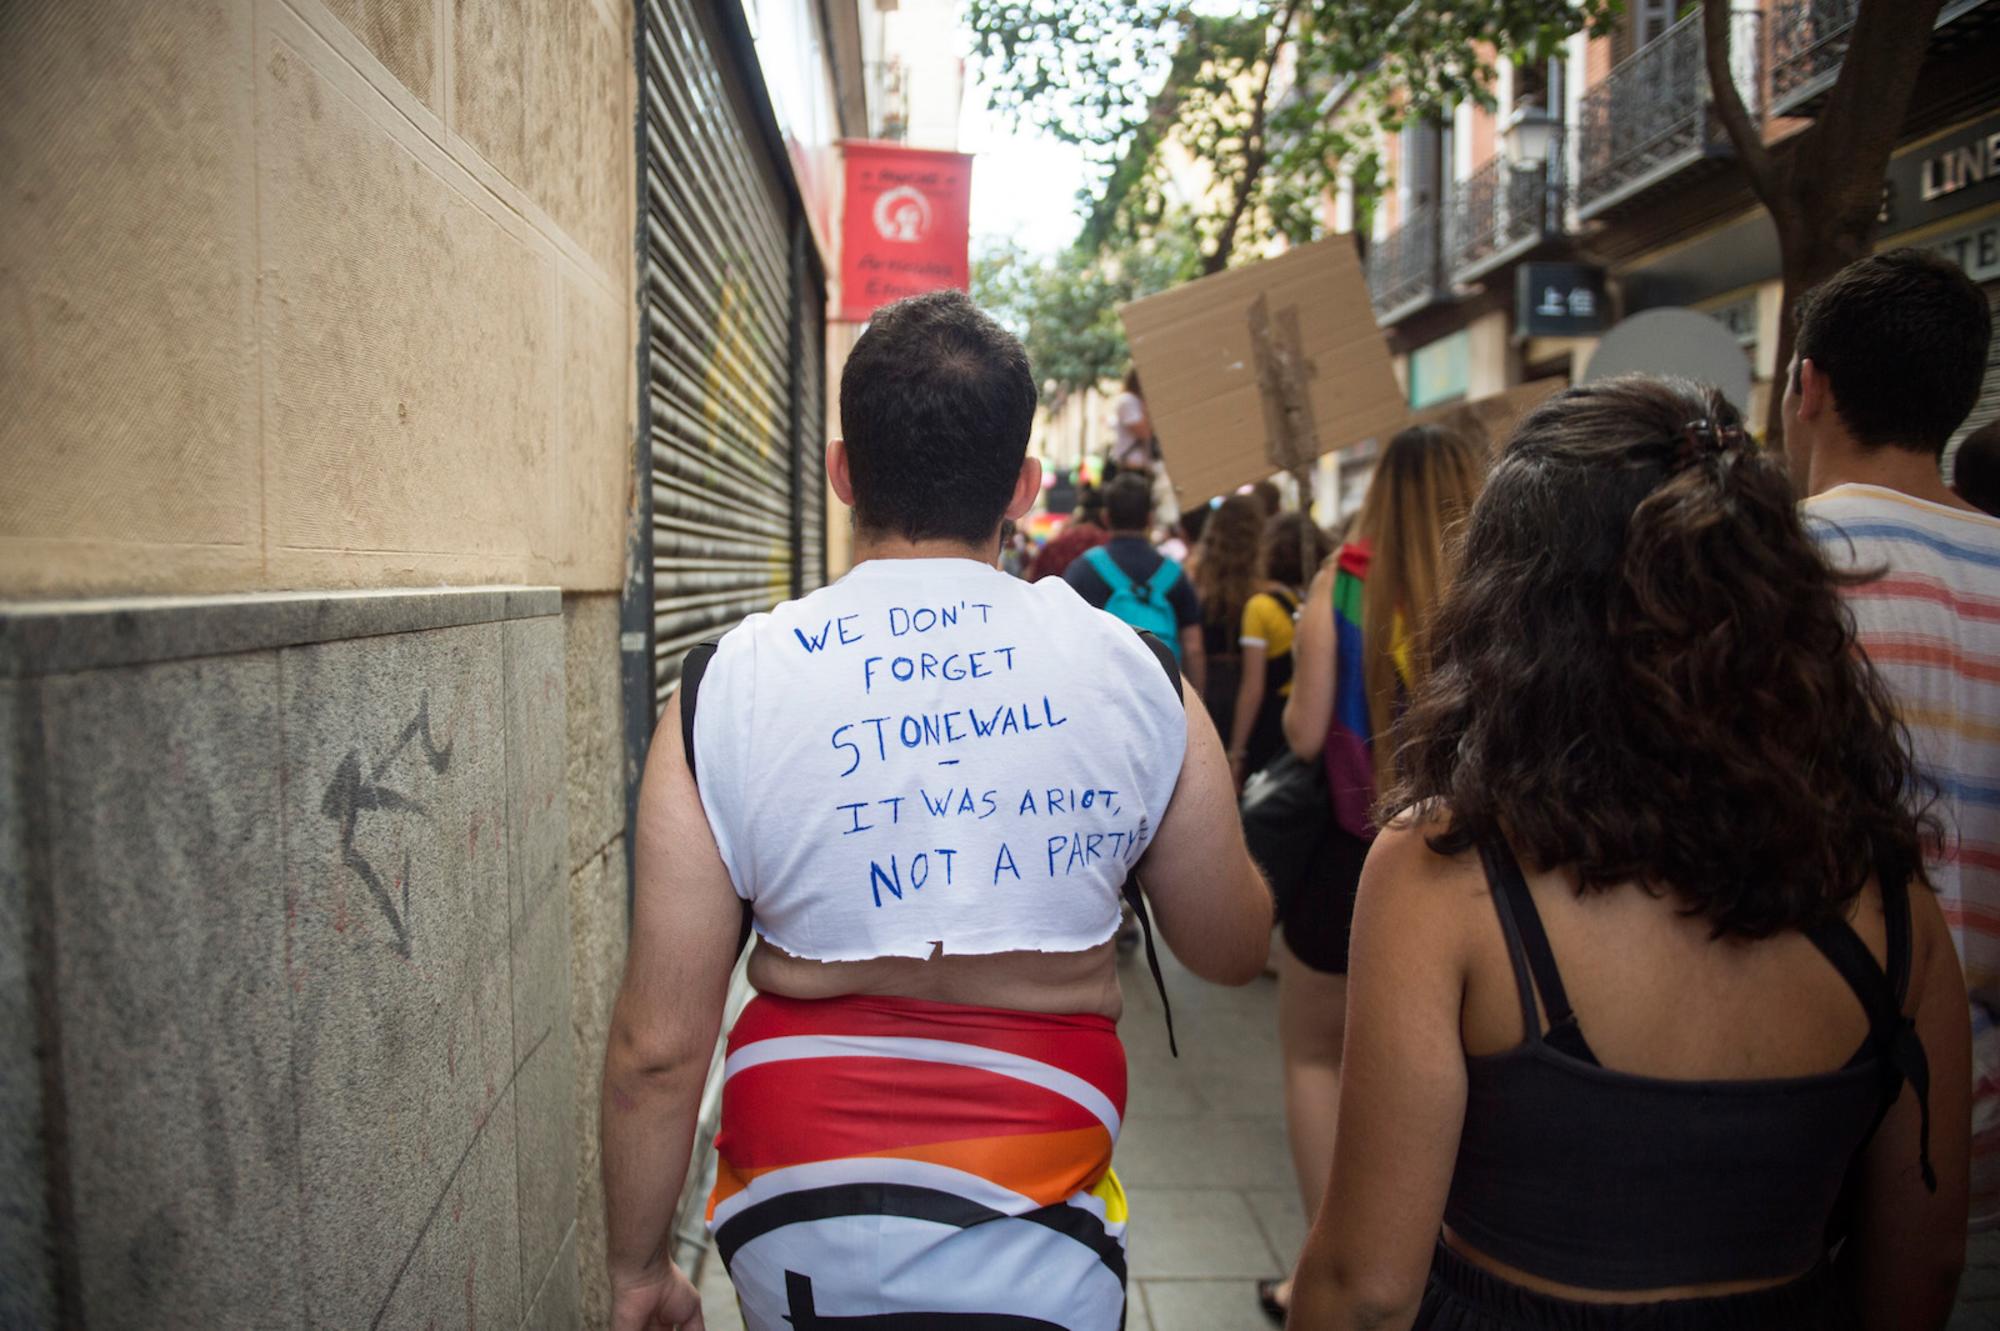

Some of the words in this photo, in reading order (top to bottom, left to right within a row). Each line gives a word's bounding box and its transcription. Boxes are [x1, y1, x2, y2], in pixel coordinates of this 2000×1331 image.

[793, 614, 863, 654] WE
[889, 601, 993, 637] DON'T
[864, 646, 1015, 693] FORGET
[831, 695, 1067, 777] STONEWALL
[836, 796, 905, 835] IT
[920, 787, 998, 818] WAS
[869, 848, 958, 908] NOT
[993, 842, 1021, 885] A
